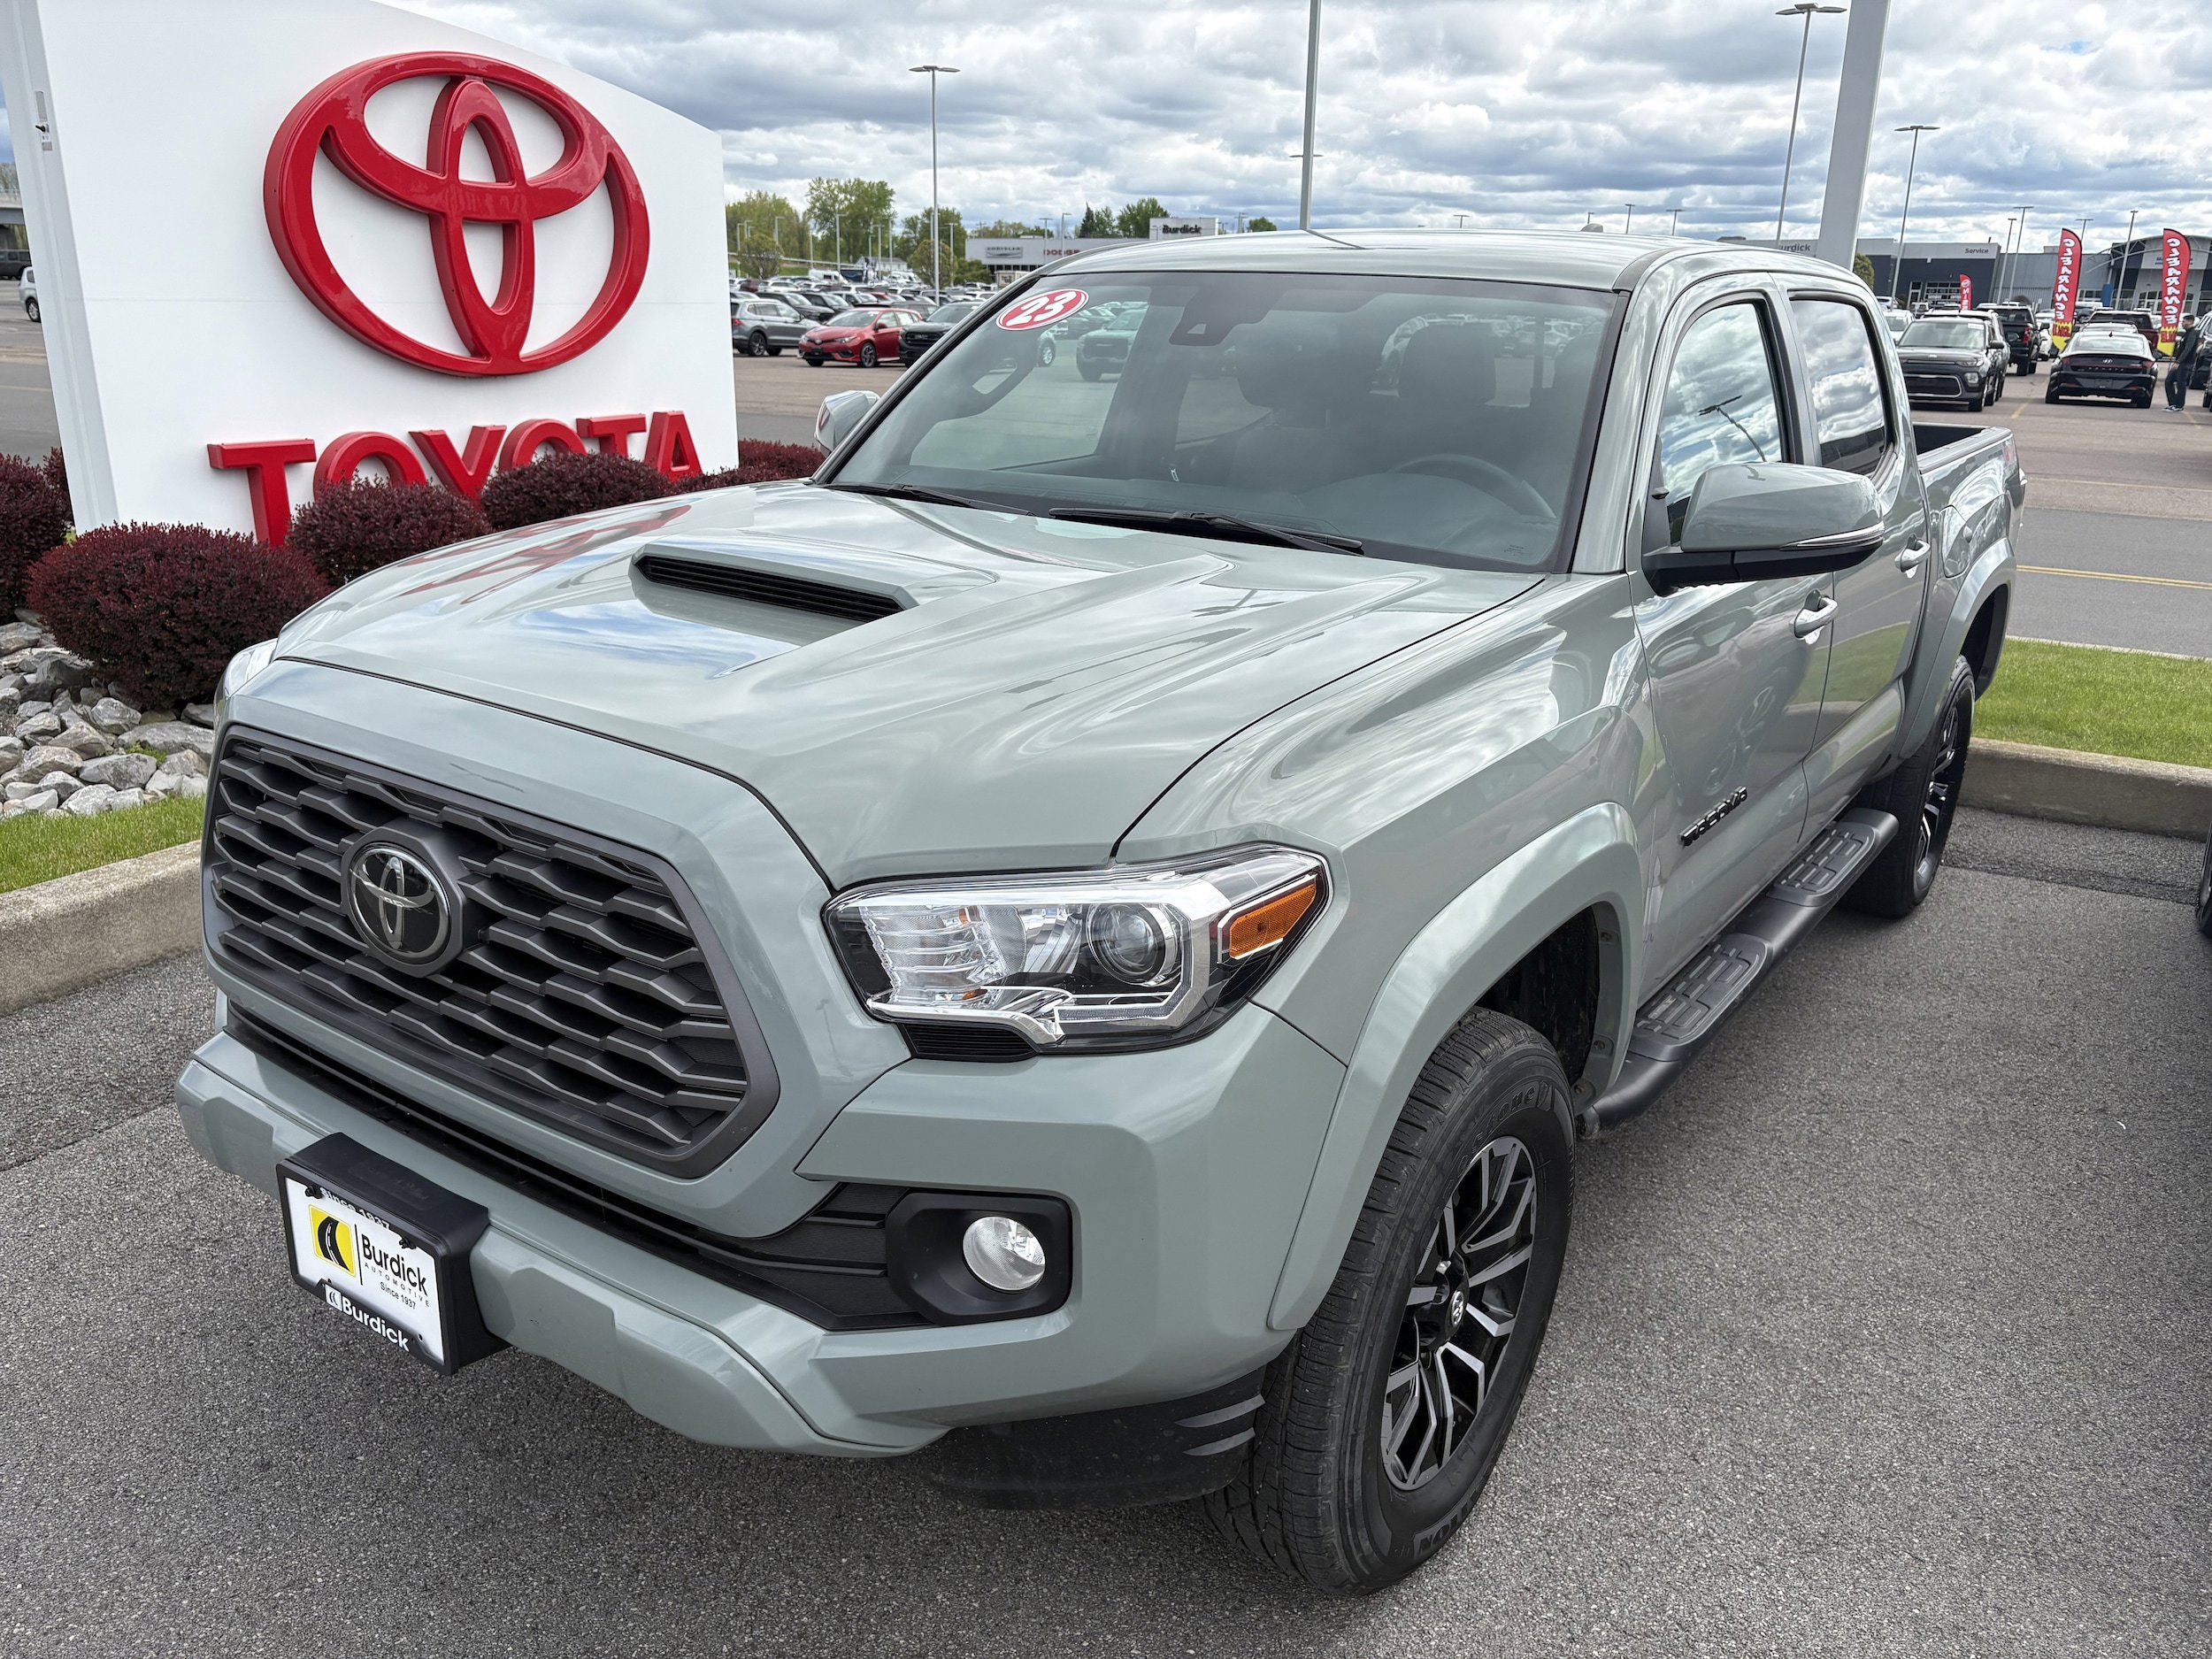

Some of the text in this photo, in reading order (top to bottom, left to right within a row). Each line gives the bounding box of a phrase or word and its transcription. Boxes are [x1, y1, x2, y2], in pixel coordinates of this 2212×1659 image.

[1163, 224, 1202, 234] Burdick
[1005, 291, 1077, 326] 23
[320, 1188, 356, 1211] Since
[361, 1233, 427, 1296] Burdick
[365, 1263, 430, 1307] AUTOMOTIVE
[380, 1282, 416, 1310] Since 1937
[342, 1296, 410, 1352] Burdick
